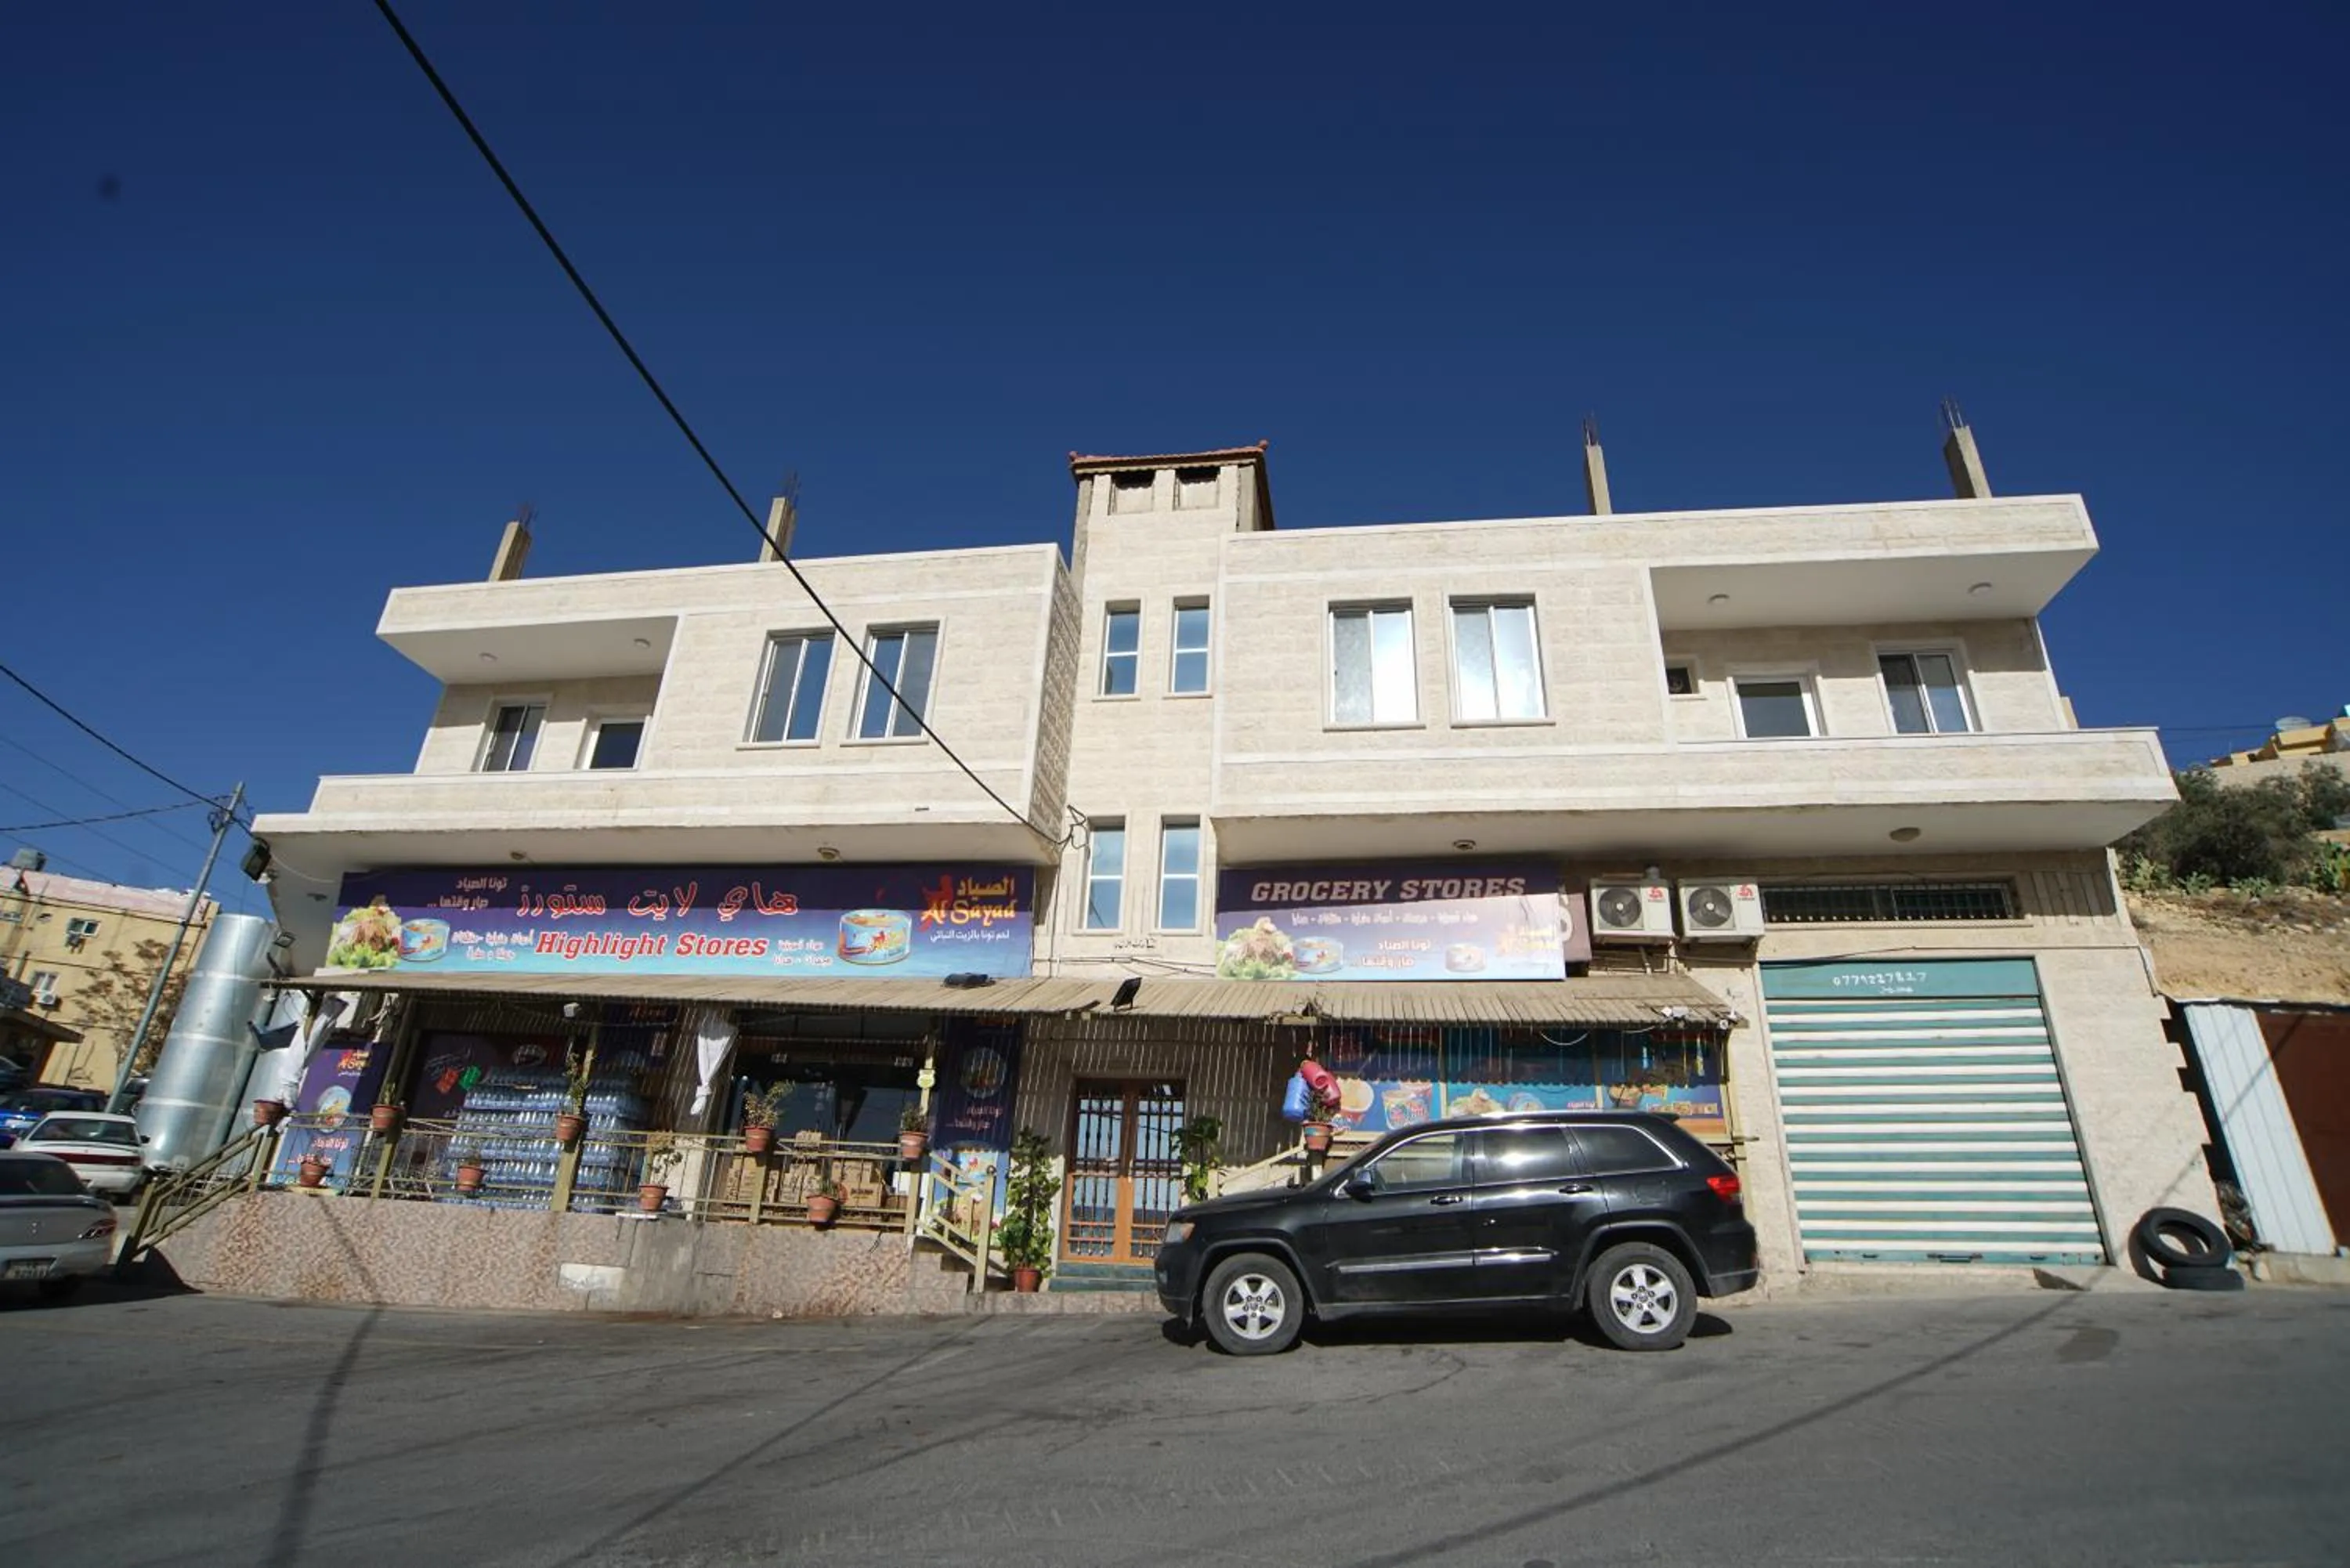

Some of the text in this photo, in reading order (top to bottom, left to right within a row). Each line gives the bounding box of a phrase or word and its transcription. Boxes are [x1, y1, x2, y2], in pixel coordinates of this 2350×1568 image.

[456, 877, 486, 891] الصياد
[956, 876, 1015, 900] الصياد
[1251, 877, 1526, 902] GROCERY STORES
[516, 881, 798, 921] هاي لايت ستورز
[921, 898, 1018, 927] Al Sayad
[535, 931, 768, 959] Highlight Stores
